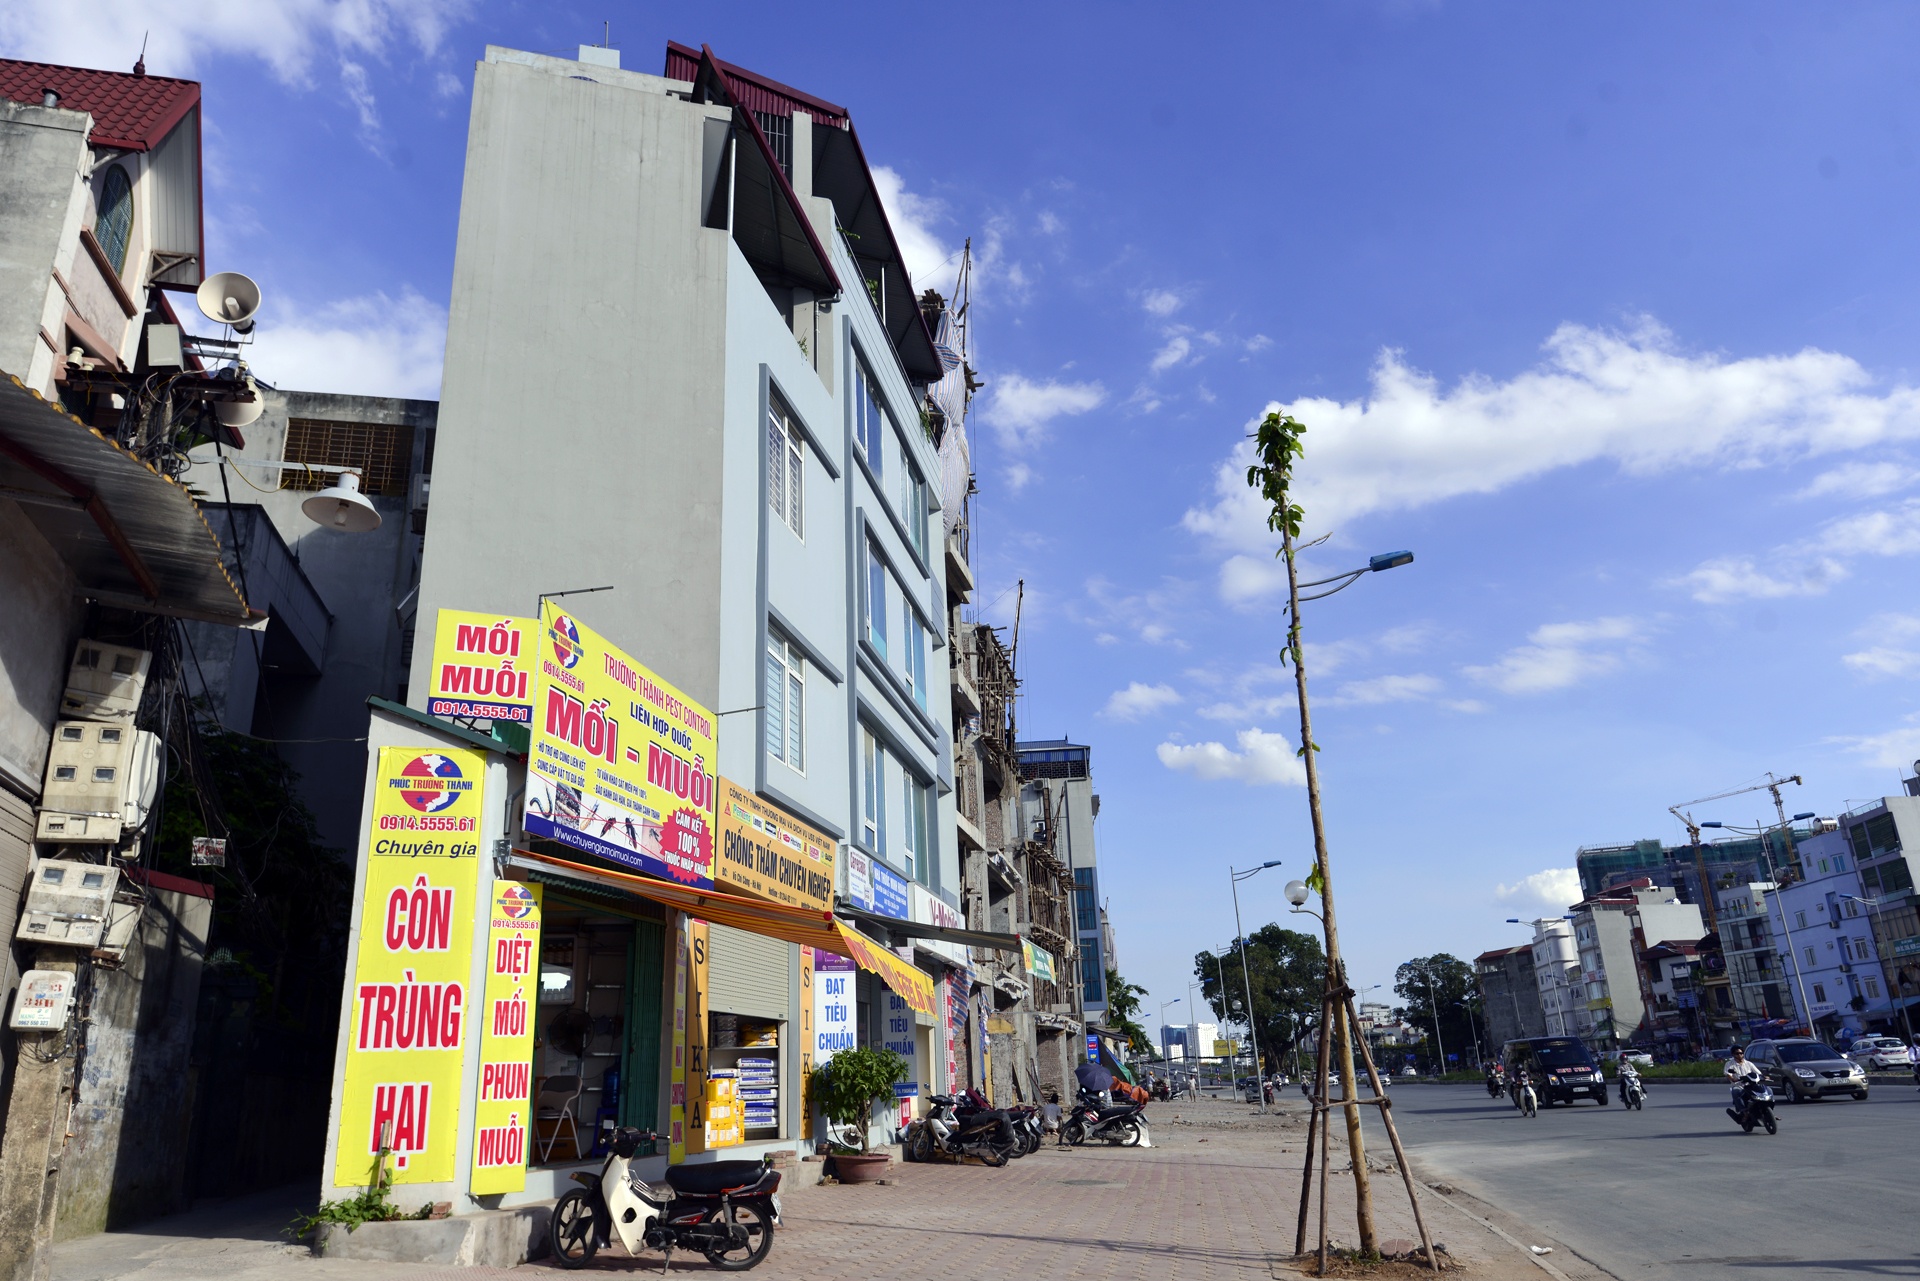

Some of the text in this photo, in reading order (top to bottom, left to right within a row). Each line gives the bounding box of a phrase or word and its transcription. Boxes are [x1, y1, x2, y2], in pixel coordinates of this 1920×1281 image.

[456, 620, 520, 657] MỐI
[440, 660, 528, 699] MUỖI
[543, 659, 585, 694] 0914.5555.61
[433, 701, 527, 720] 0914.5555.61
[638, 675, 664, 710] THÀNH
[665, 694, 683, 721] PEST
[683, 704, 712, 740] CONTROL
[630, 701, 692, 751] LIÊN HỢP QUỐC
[545, 685, 618, 766] MỐI
[647, 740, 714, 814] MUỖI
[389, 777, 411, 788] PHÚC
[446, 780, 473, 791] THÀNH
[729, 787, 743, 802] CÔNG
[743, 795, 749, 805] TY
[379, 814, 476, 832] 0914.5555.61
[675, 810, 703, 835] CAM KẾT
[375, 839, 478, 859] Chuyên gia
[553, 826, 643, 867] Www.chuyengiamoimuoi.com
[664, 850, 681, 867] THUỐC
[677, 830, 701, 858] 100%
[724, 825, 754, 870] CHỐNG
[755, 840, 778, 881] THẤM
[779, 859, 807, 894] CHUYÊN
[807, 872, 831, 908] NGHIỆP
[386, 875, 453, 951] CÔN
[492, 918, 540, 930] 0914.5555.61
[495, 932, 532, 982] DIỆT
[825, 977, 846, 999] ĐẠT
[358, 970, 463, 1049] TRÙNG
[493, 988, 527, 1036] MỐI
[824, 1001, 847, 1022] TIÊU
[889, 995, 906, 1013] ĐẠT
[818, 1025, 854, 1051] CHUẨN
[889, 1016, 909, 1033] TIÊU
[884, 1035, 915, 1056] CHUẨN
[481, 1063, 530, 1100] PHUN
[371, 1084, 430, 1168] HẠI
[477, 1113, 524, 1167] MUỖI
